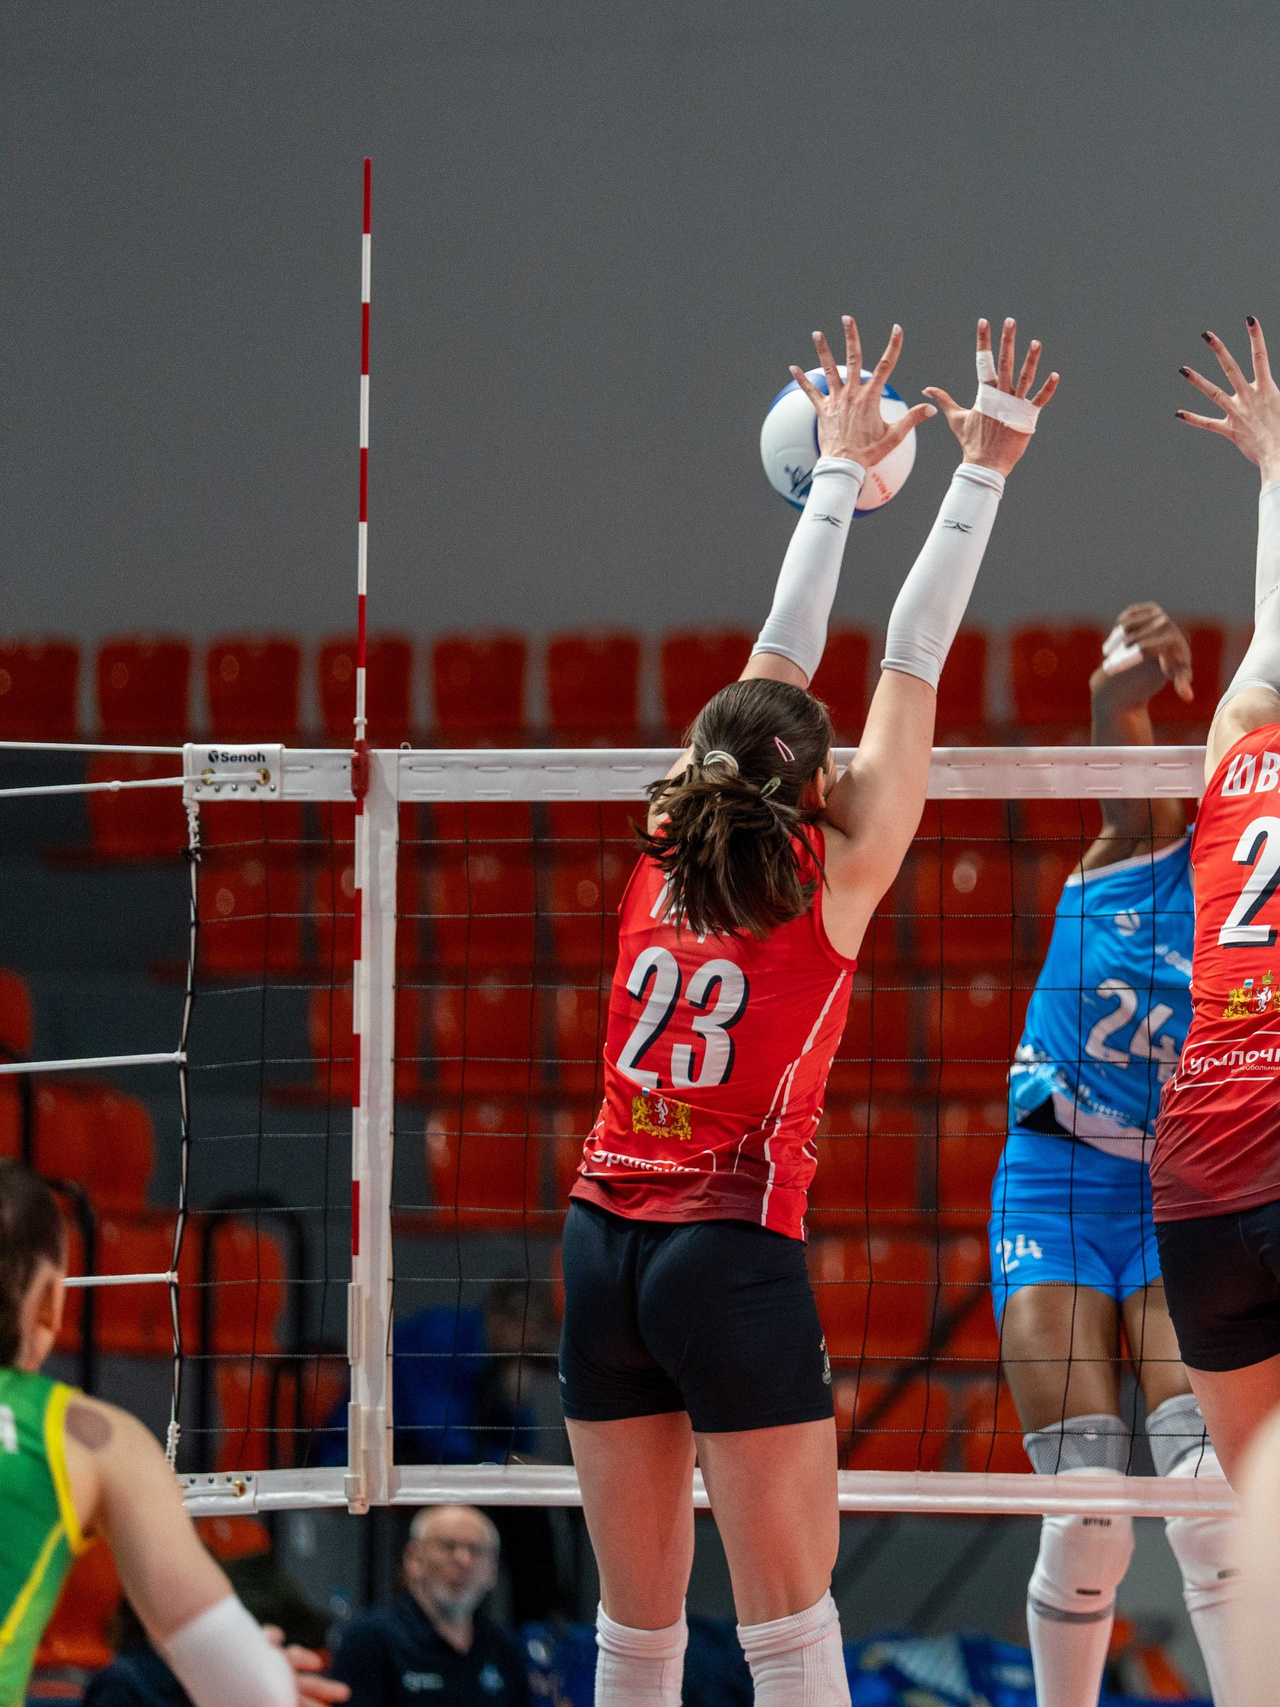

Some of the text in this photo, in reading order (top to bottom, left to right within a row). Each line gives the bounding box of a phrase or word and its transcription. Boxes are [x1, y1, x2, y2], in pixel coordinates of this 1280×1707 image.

[221, 751, 266, 762] Senoh
[616, 946, 750, 1089] 23
[1084, 977, 1180, 1083] 24
[995, 1234, 1043, 1274] 24
